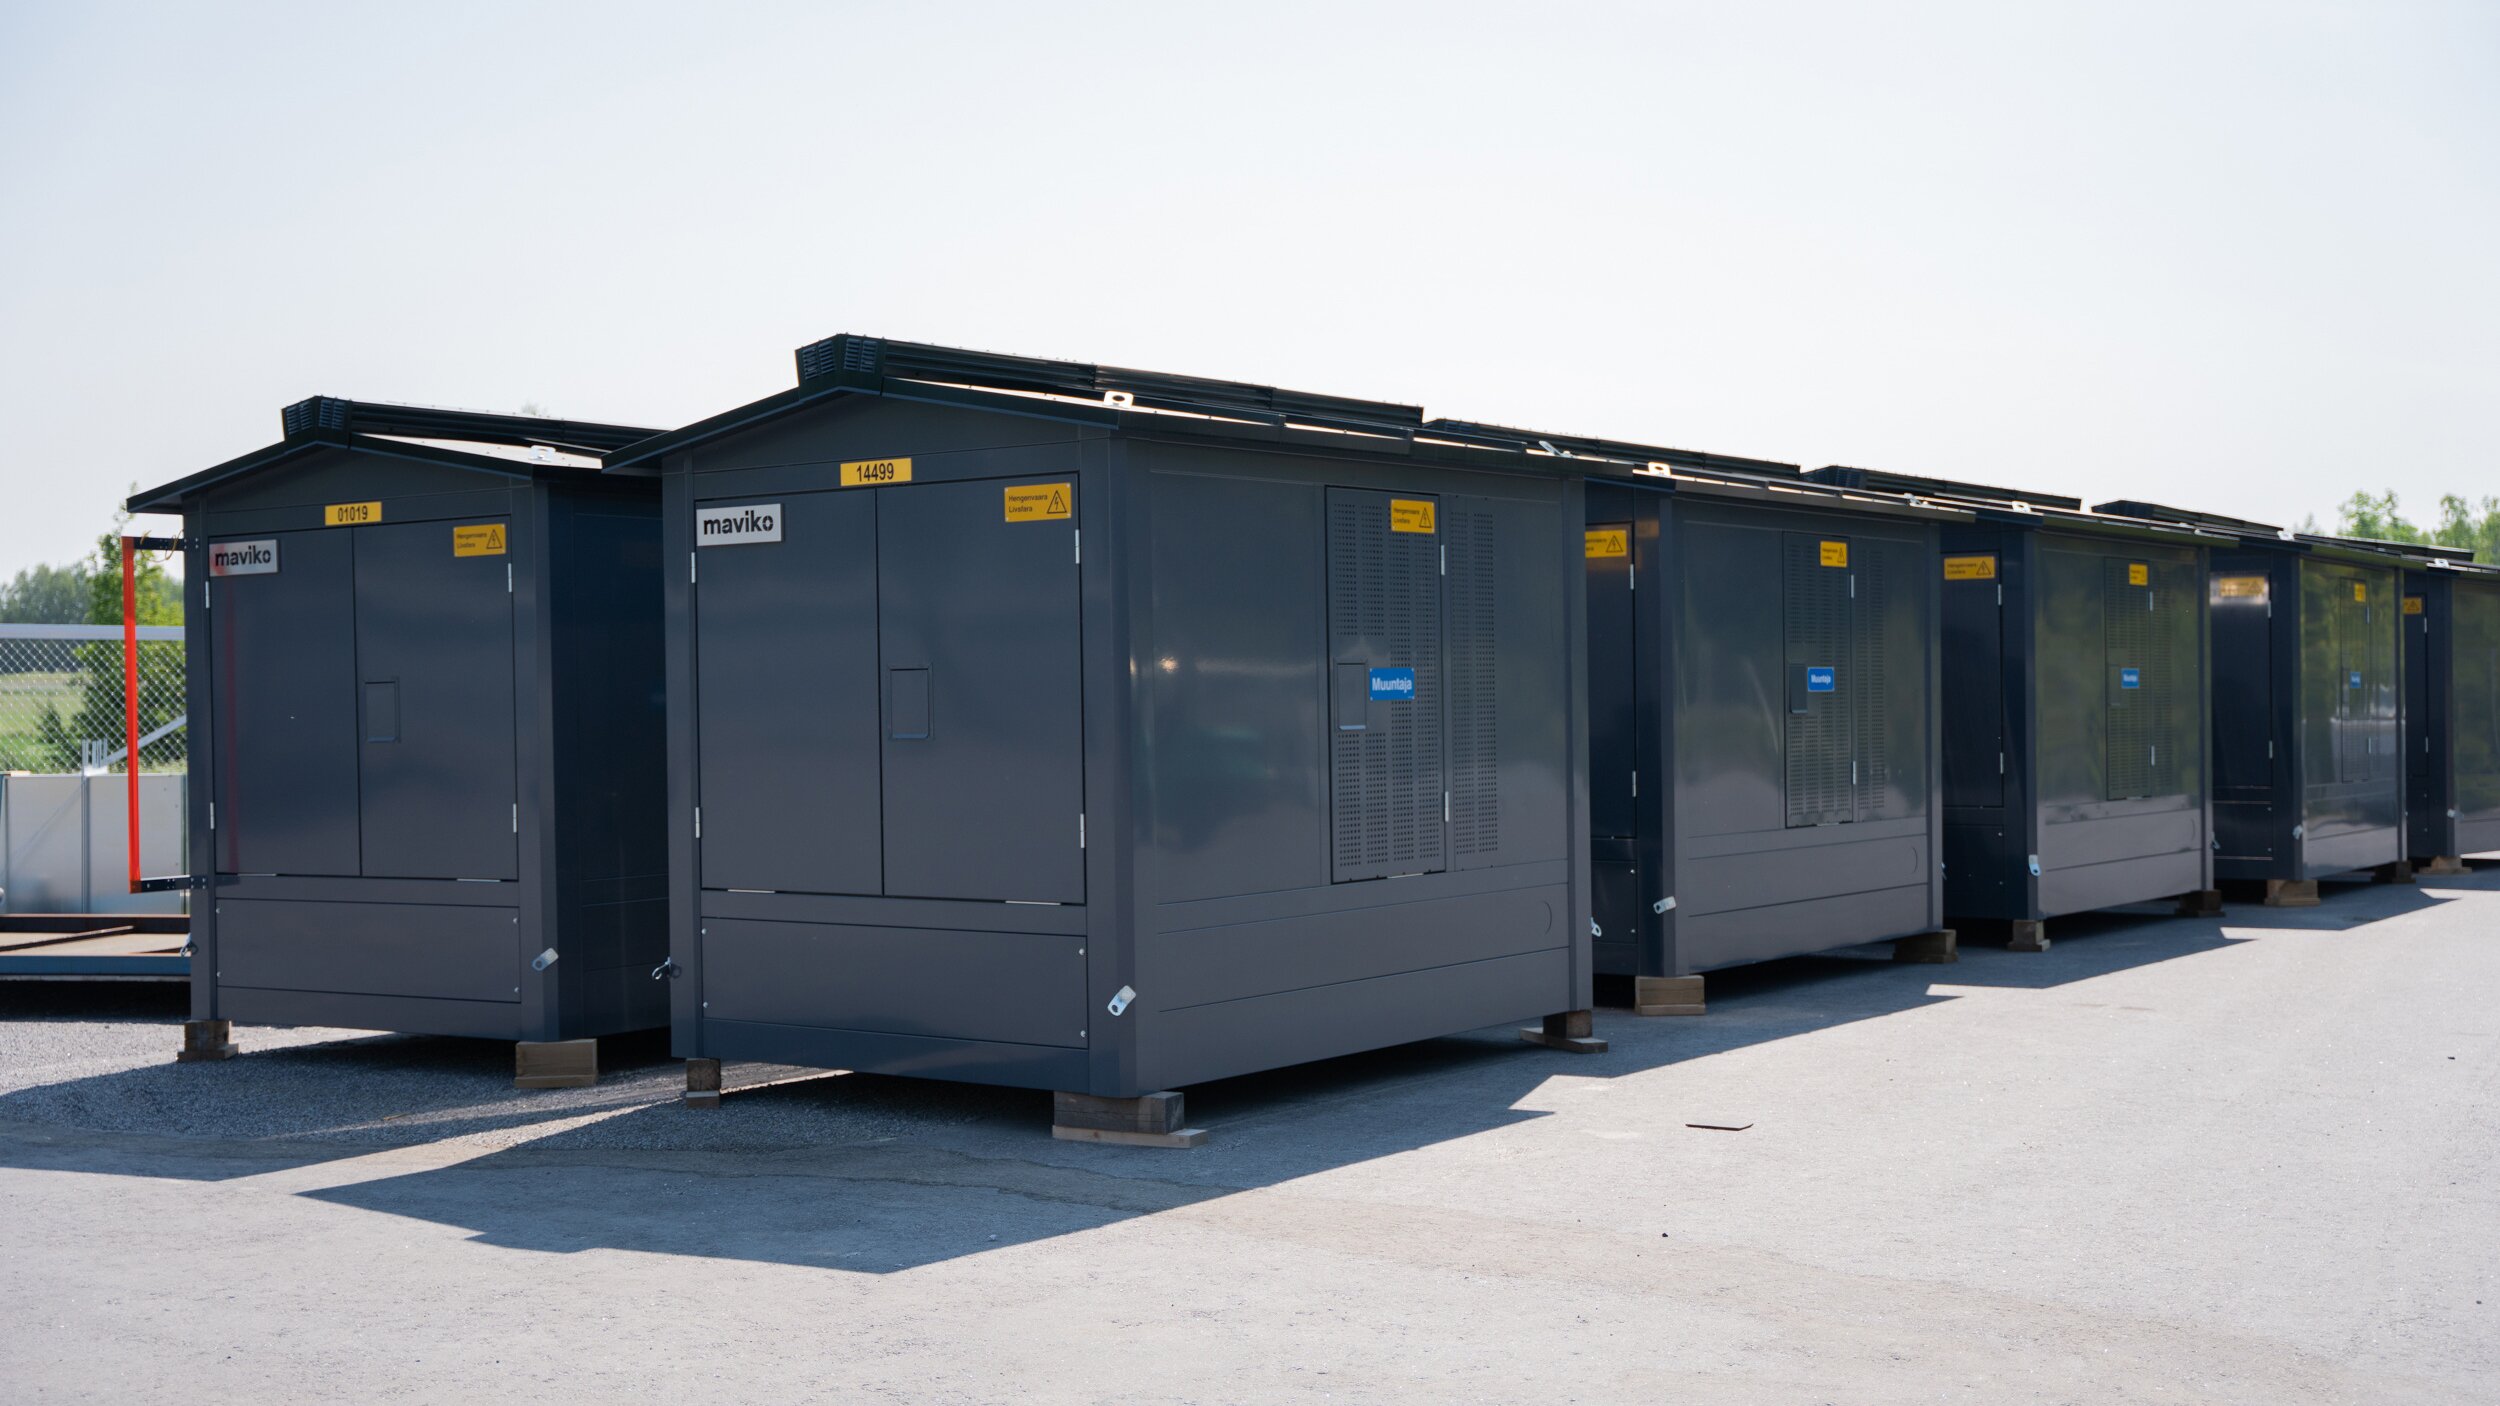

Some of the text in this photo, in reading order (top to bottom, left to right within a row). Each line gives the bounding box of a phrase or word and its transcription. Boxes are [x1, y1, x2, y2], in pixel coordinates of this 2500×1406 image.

[856, 462, 895, 482] 14499
[1008, 494, 1048, 503] Hengenvaara
[337, 505, 368, 522] 01019
[703, 510, 774, 535] maviko
[215, 545, 272, 567] maviko
[1372, 677, 1412, 693] Muuntaja
